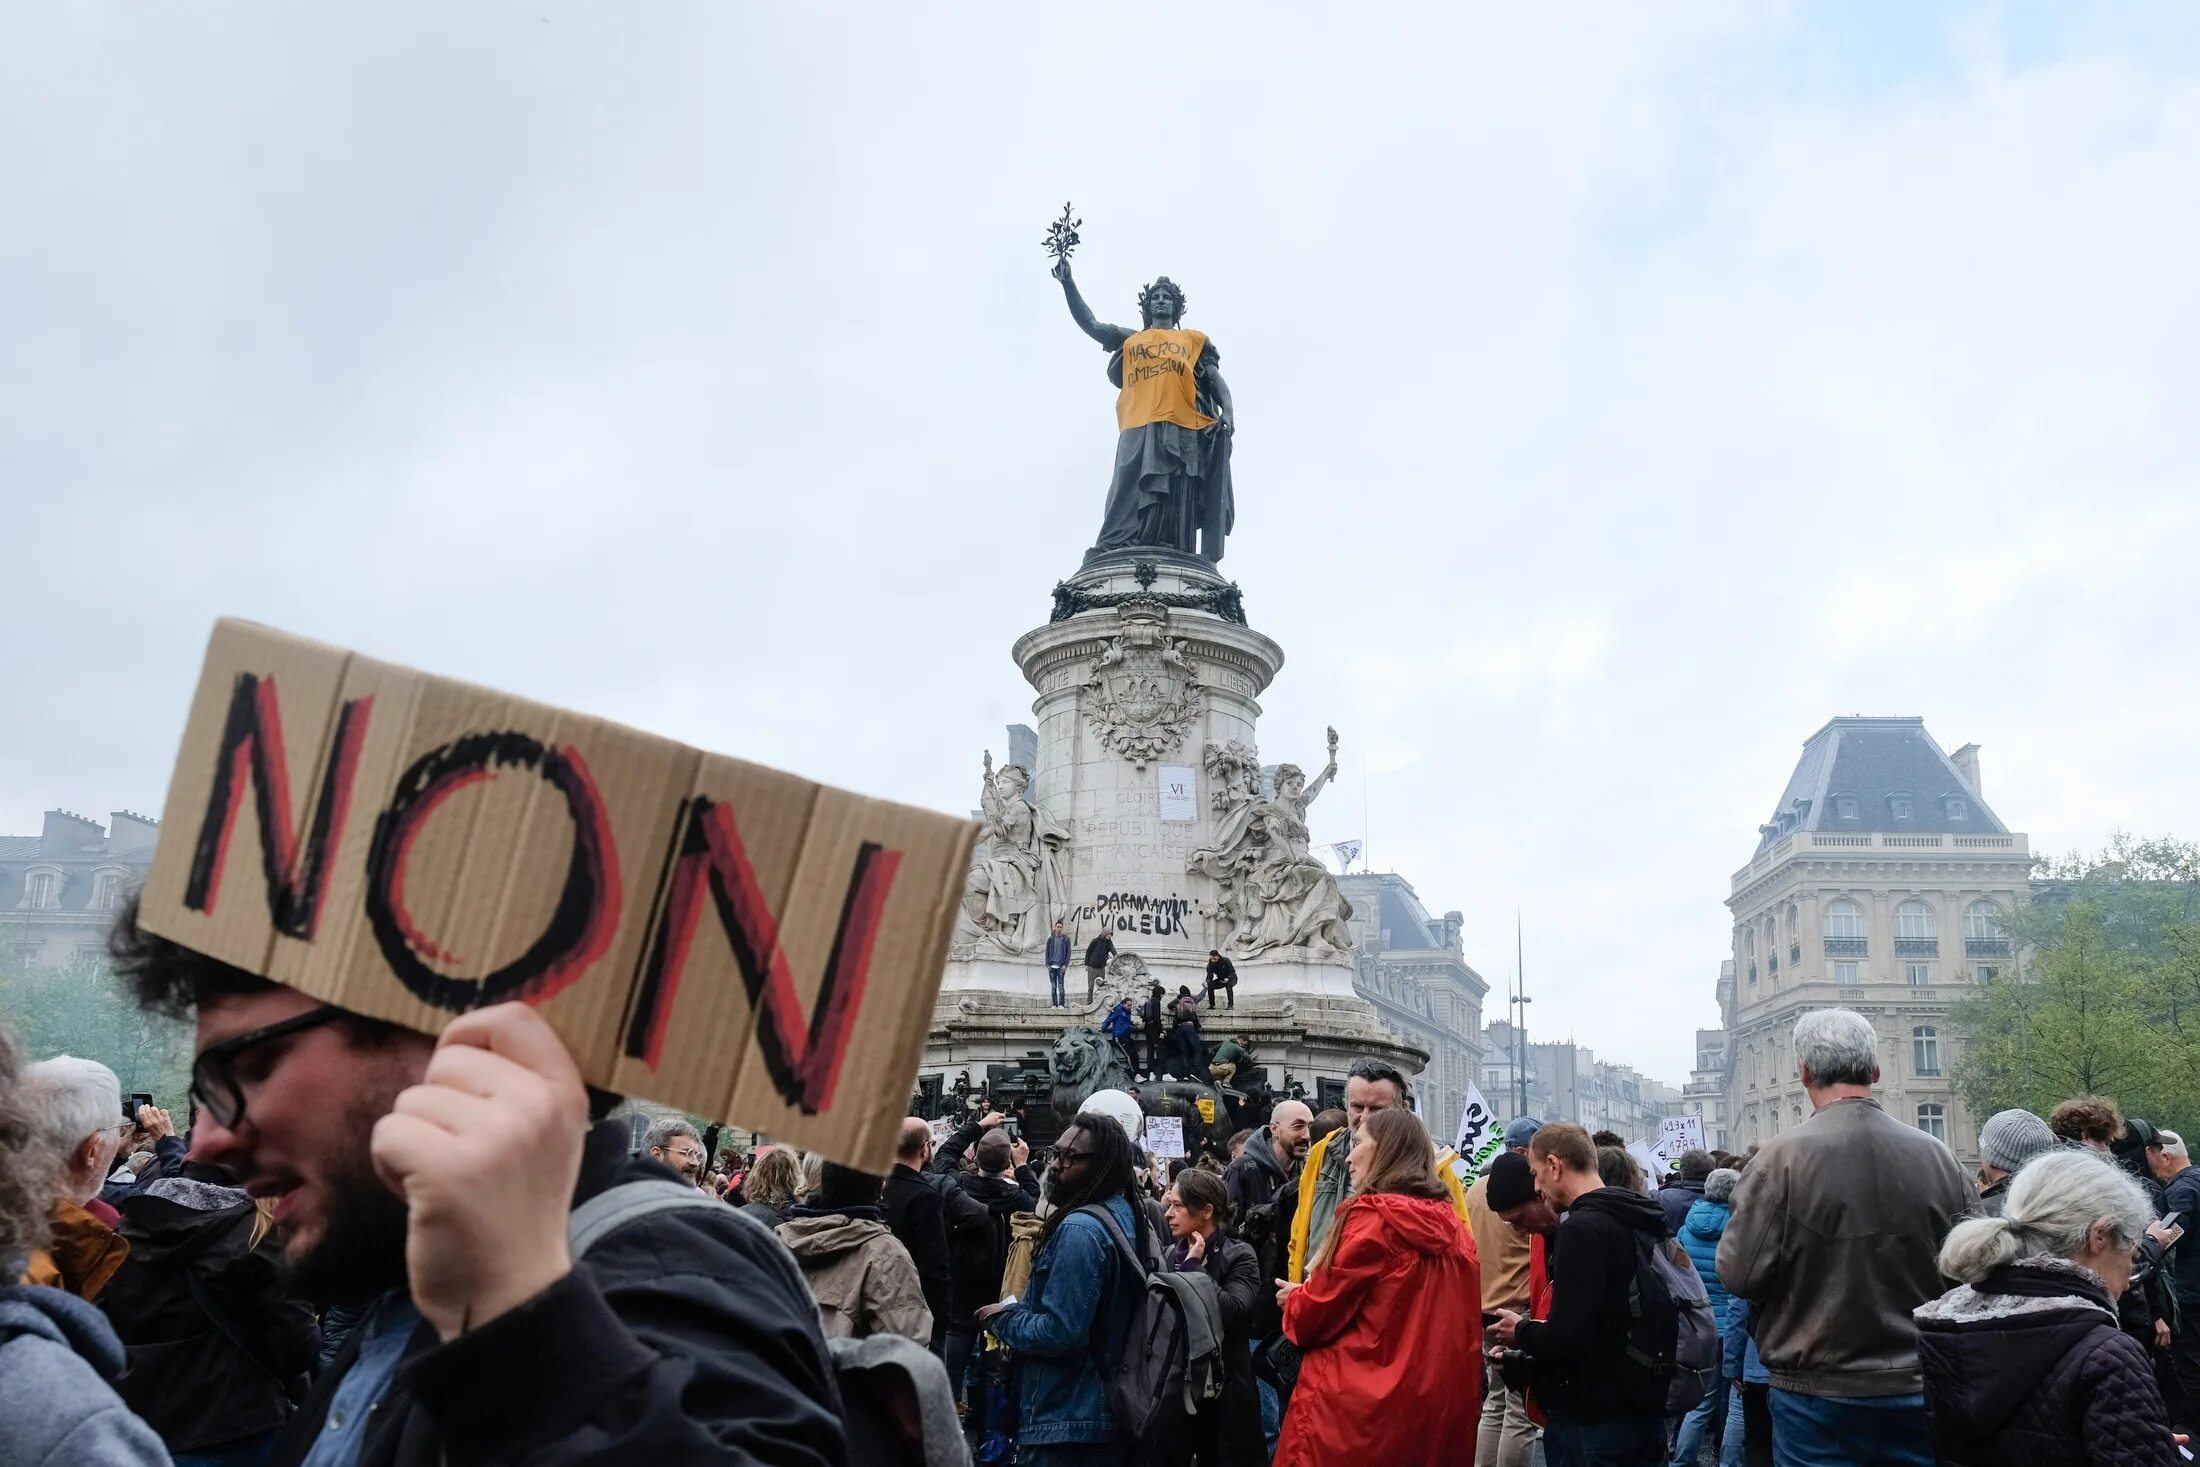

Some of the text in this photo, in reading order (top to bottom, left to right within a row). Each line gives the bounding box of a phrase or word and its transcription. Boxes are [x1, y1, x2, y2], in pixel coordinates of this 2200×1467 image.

[1128, 341, 1190, 364] MACRON
[184, 672, 904, 1116] NON
[1669, 1138, 1696, 1152] 1789
